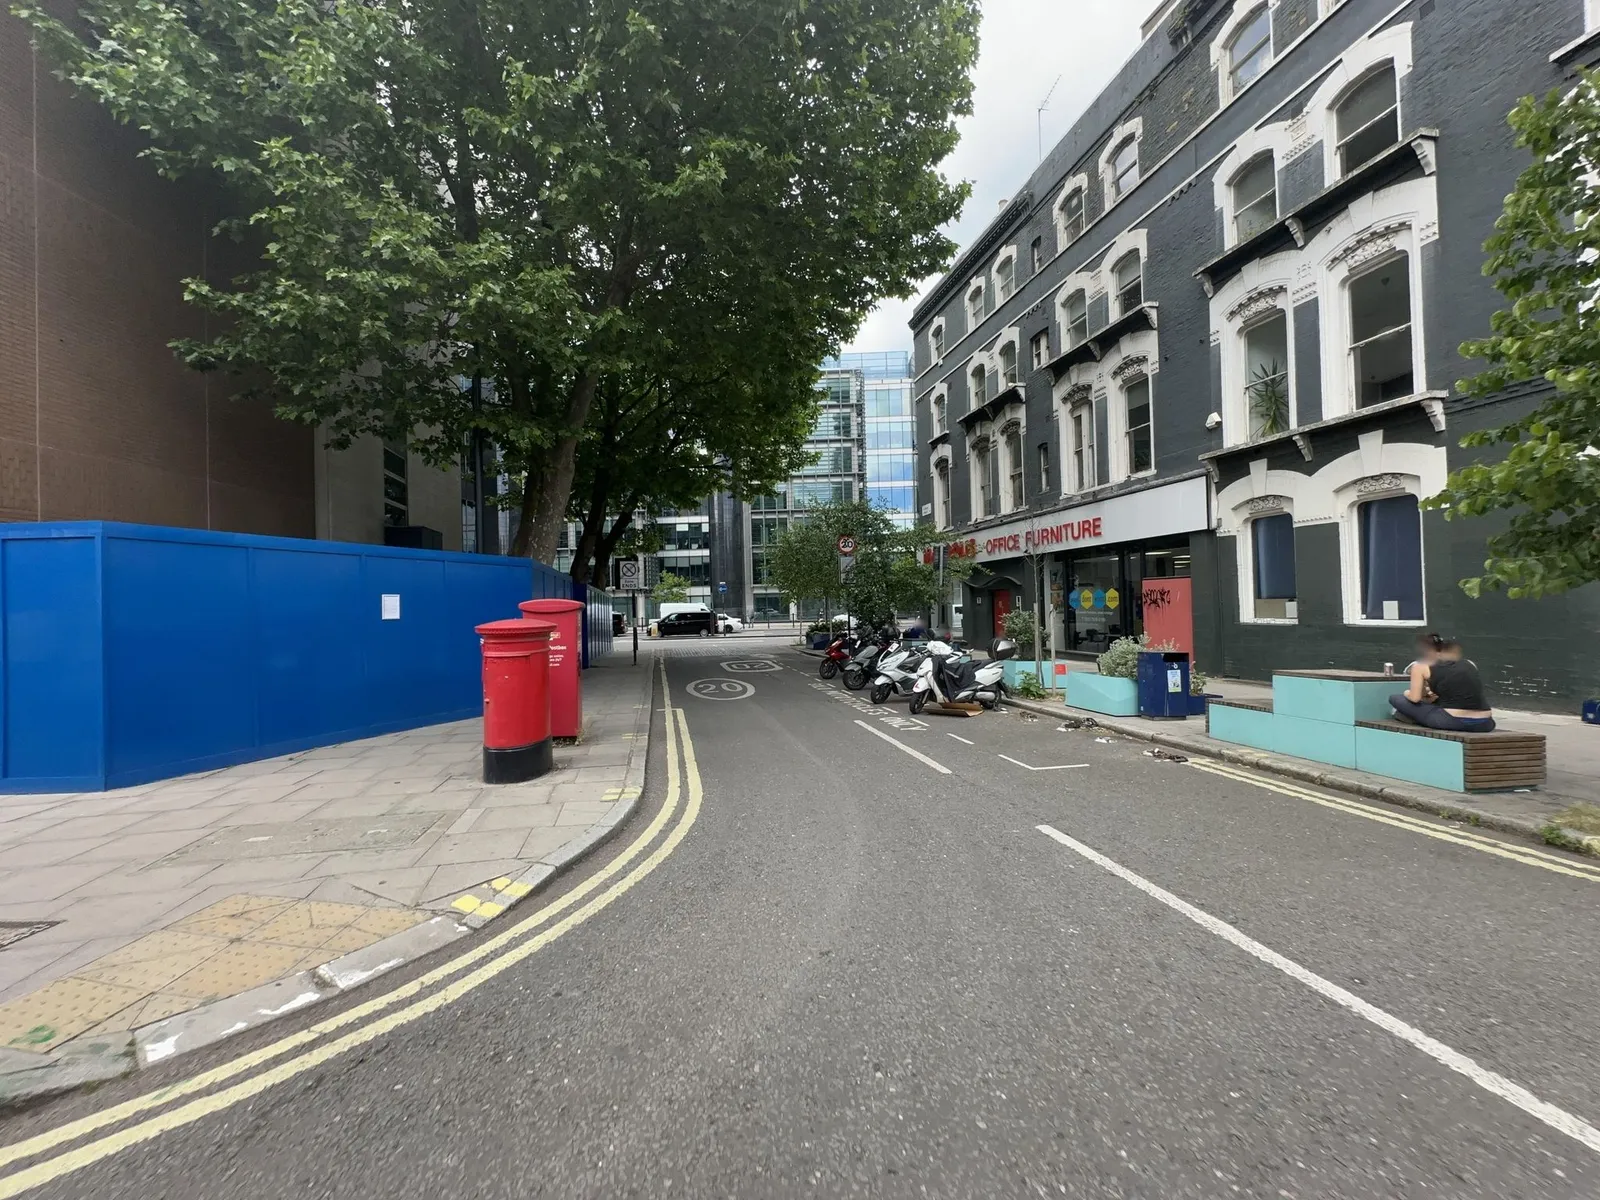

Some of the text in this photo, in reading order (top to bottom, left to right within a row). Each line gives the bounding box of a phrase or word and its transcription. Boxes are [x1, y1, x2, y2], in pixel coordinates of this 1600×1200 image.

[985, 534, 1020, 555] OFFICE
[1025, 517, 1102, 548] FURNITURE
[841, 540, 854, 549] 20
[698, 683, 743, 693] 20
[879, 716, 928, 731] ONLY
